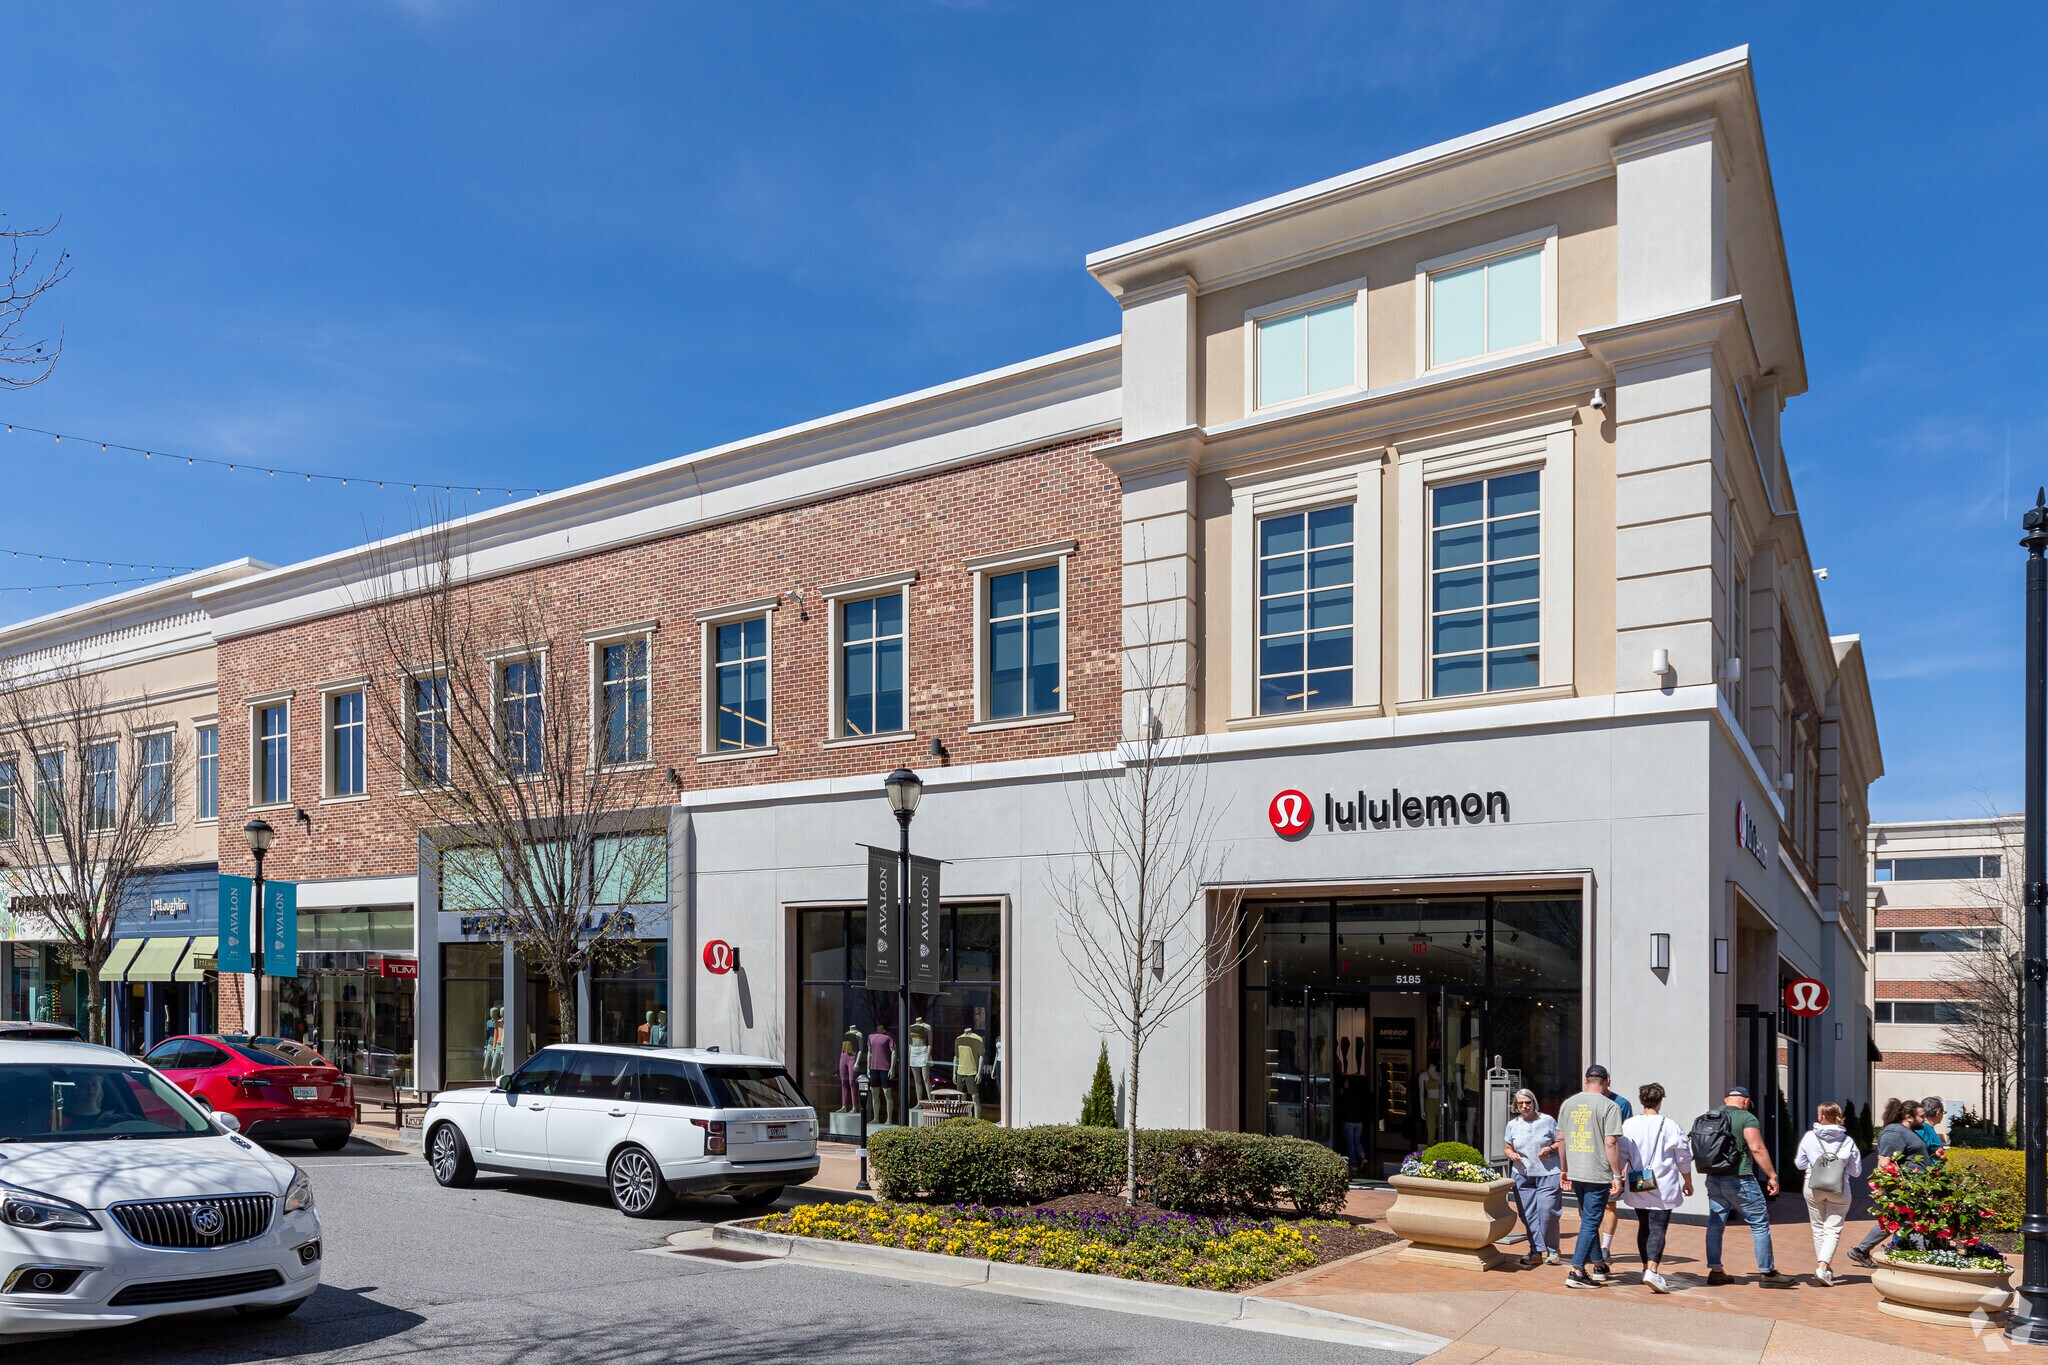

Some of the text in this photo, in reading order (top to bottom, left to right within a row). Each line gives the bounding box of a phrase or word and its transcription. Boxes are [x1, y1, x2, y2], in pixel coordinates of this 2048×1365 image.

[1325, 788, 1507, 825] lululemon
[230, 887, 239, 935] AVALON
[276, 892, 284, 939] AVALON
[879, 866, 887, 936] AVALON
[921, 875, 929, 941] AVALON
[389, 964, 416, 974] TUMI
[1396, 975, 1421, 984] 5185
